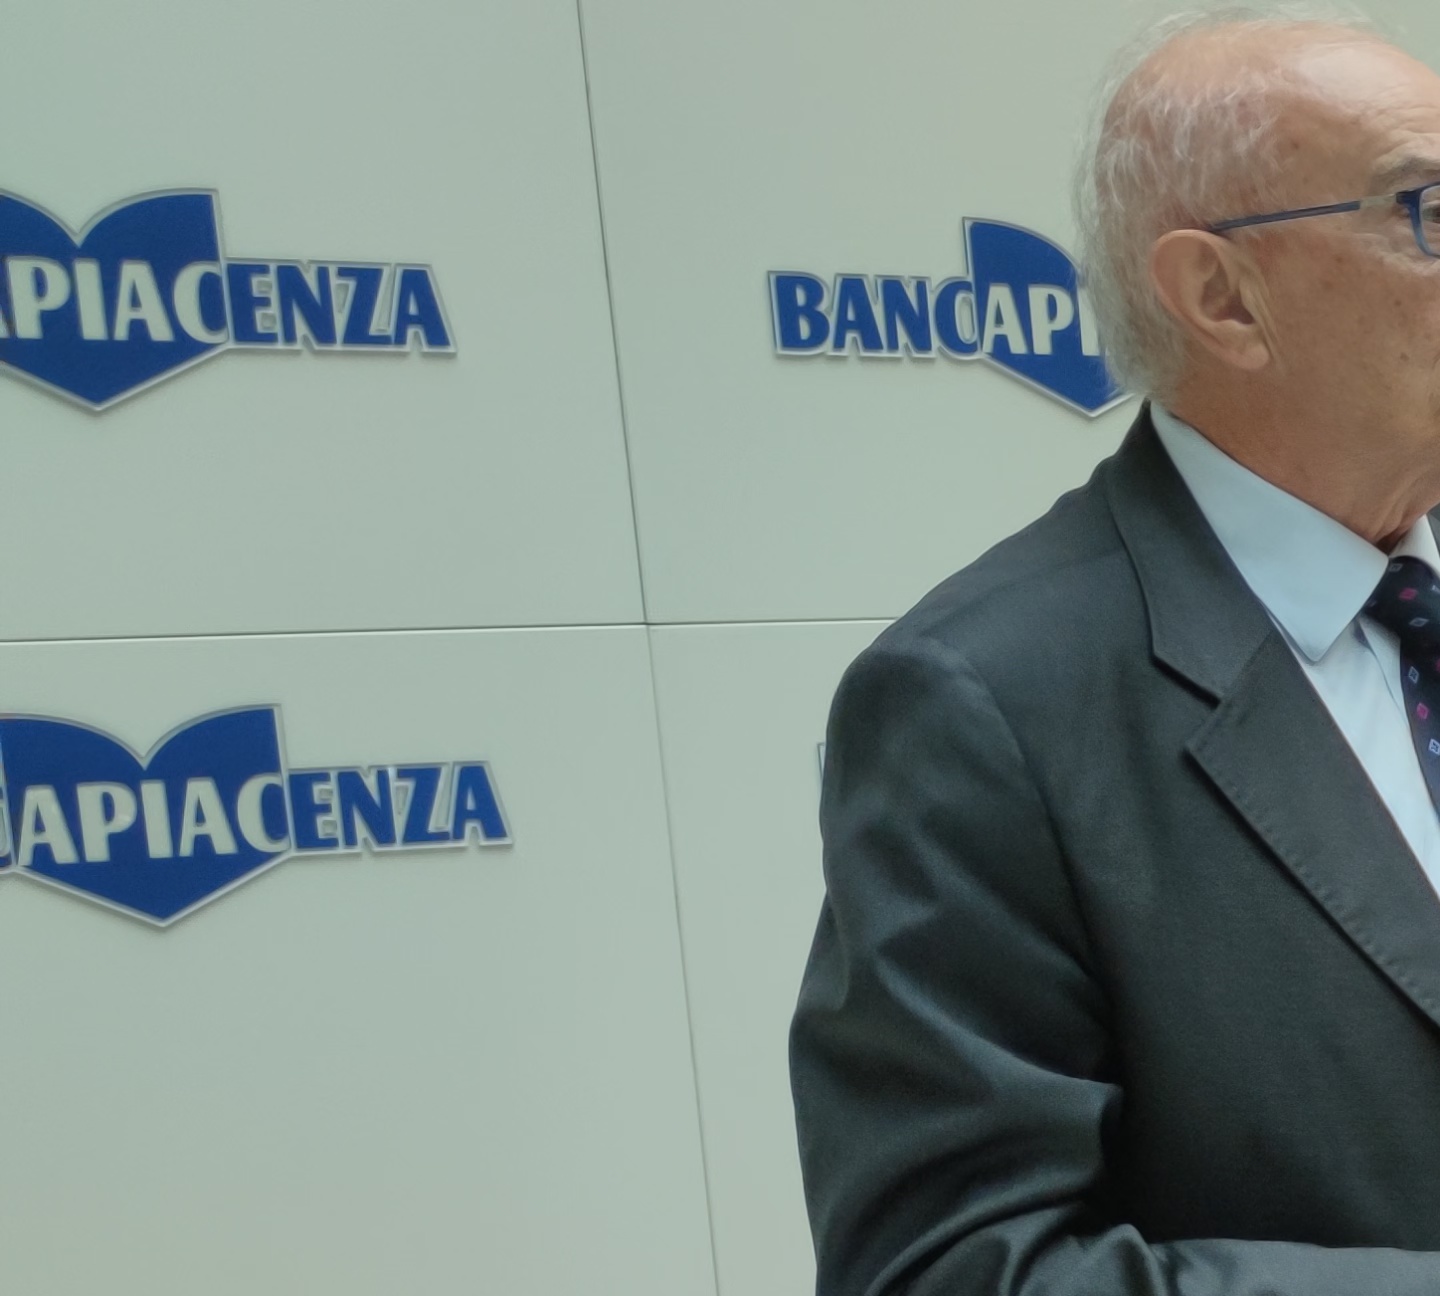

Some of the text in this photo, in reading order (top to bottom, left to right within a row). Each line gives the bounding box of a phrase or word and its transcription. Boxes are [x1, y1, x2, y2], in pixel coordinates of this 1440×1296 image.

[0, 258, 452, 348] PIACENZA
[776, 275, 1100, 357] BANCAPI
[0, 765, 508, 867] APIACENZA
